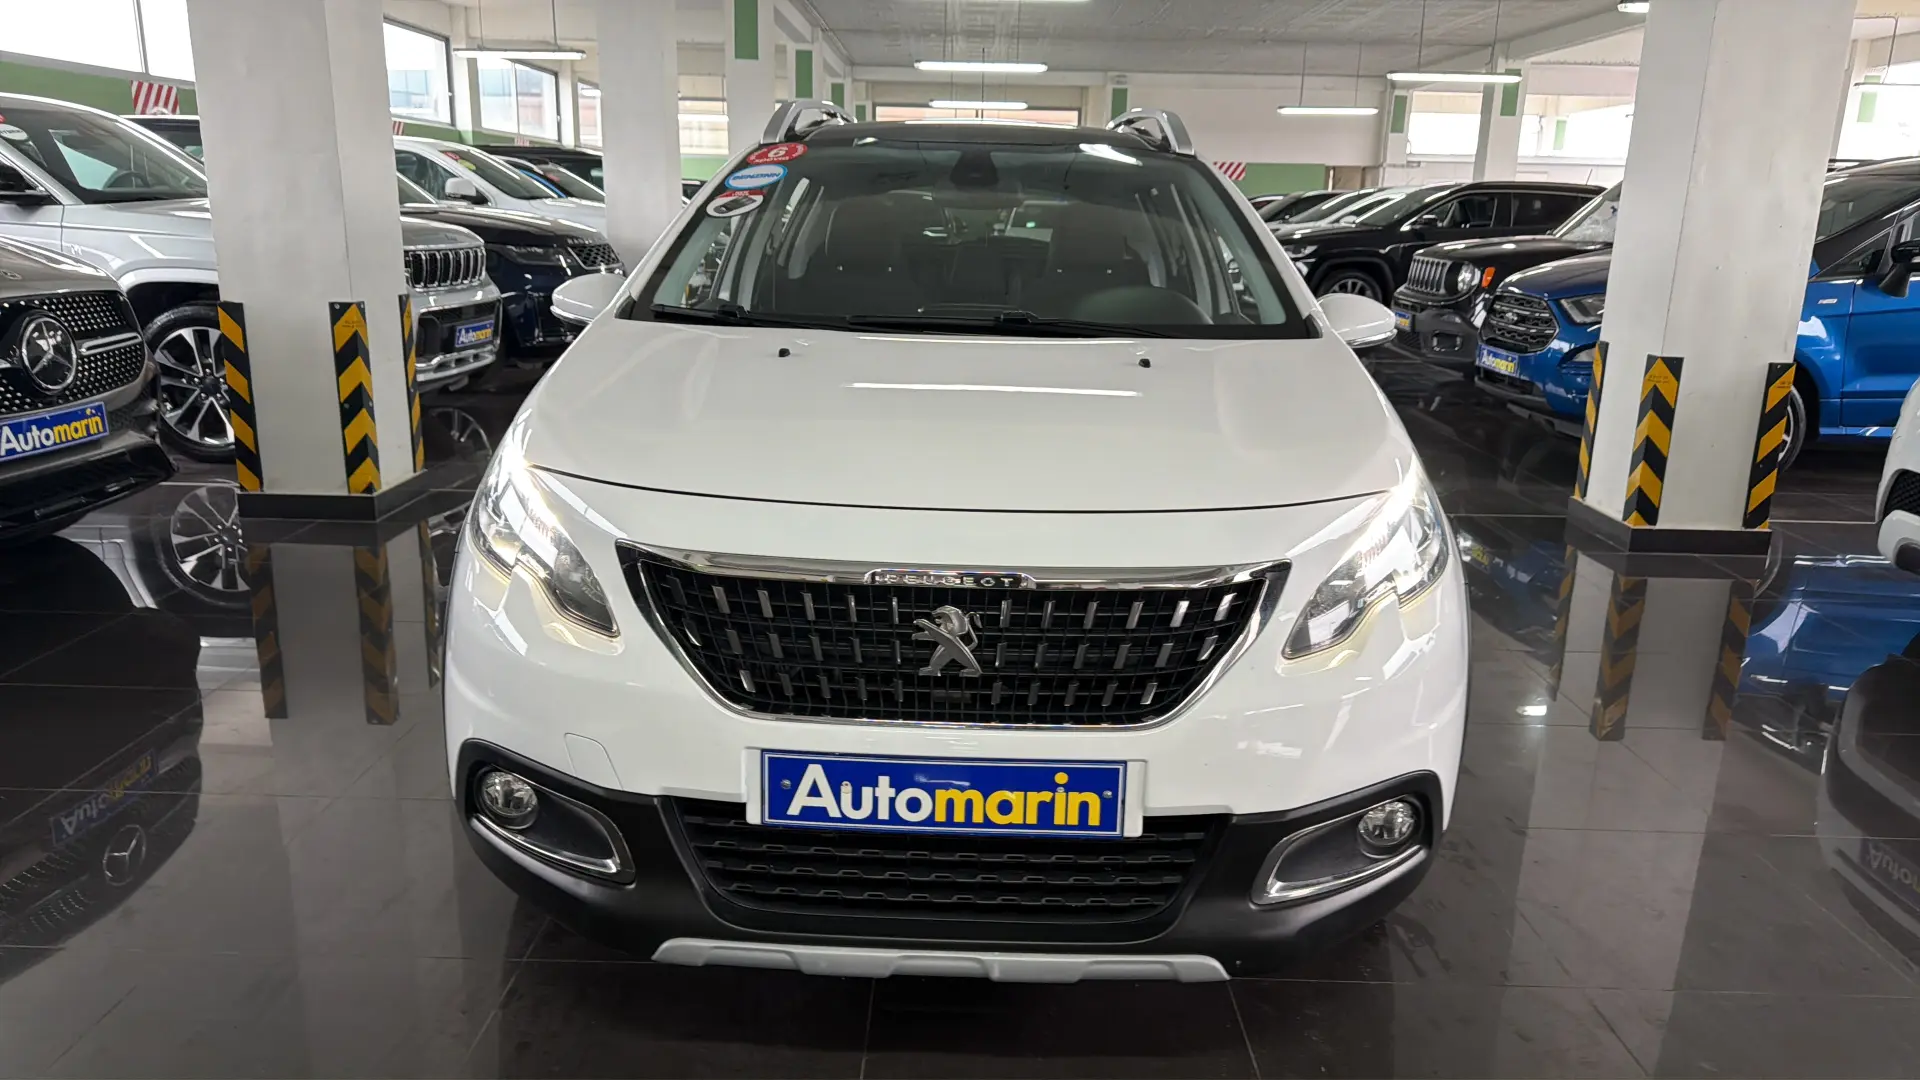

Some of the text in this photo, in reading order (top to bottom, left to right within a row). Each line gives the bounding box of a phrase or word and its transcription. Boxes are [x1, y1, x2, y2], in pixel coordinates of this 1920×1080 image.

[768, 147, 788, 157] 6
[0, 408, 104, 456] Automarin
[886, 573, 1014, 587] PEUGEOT
[787, 763, 1101, 826] Automarin
